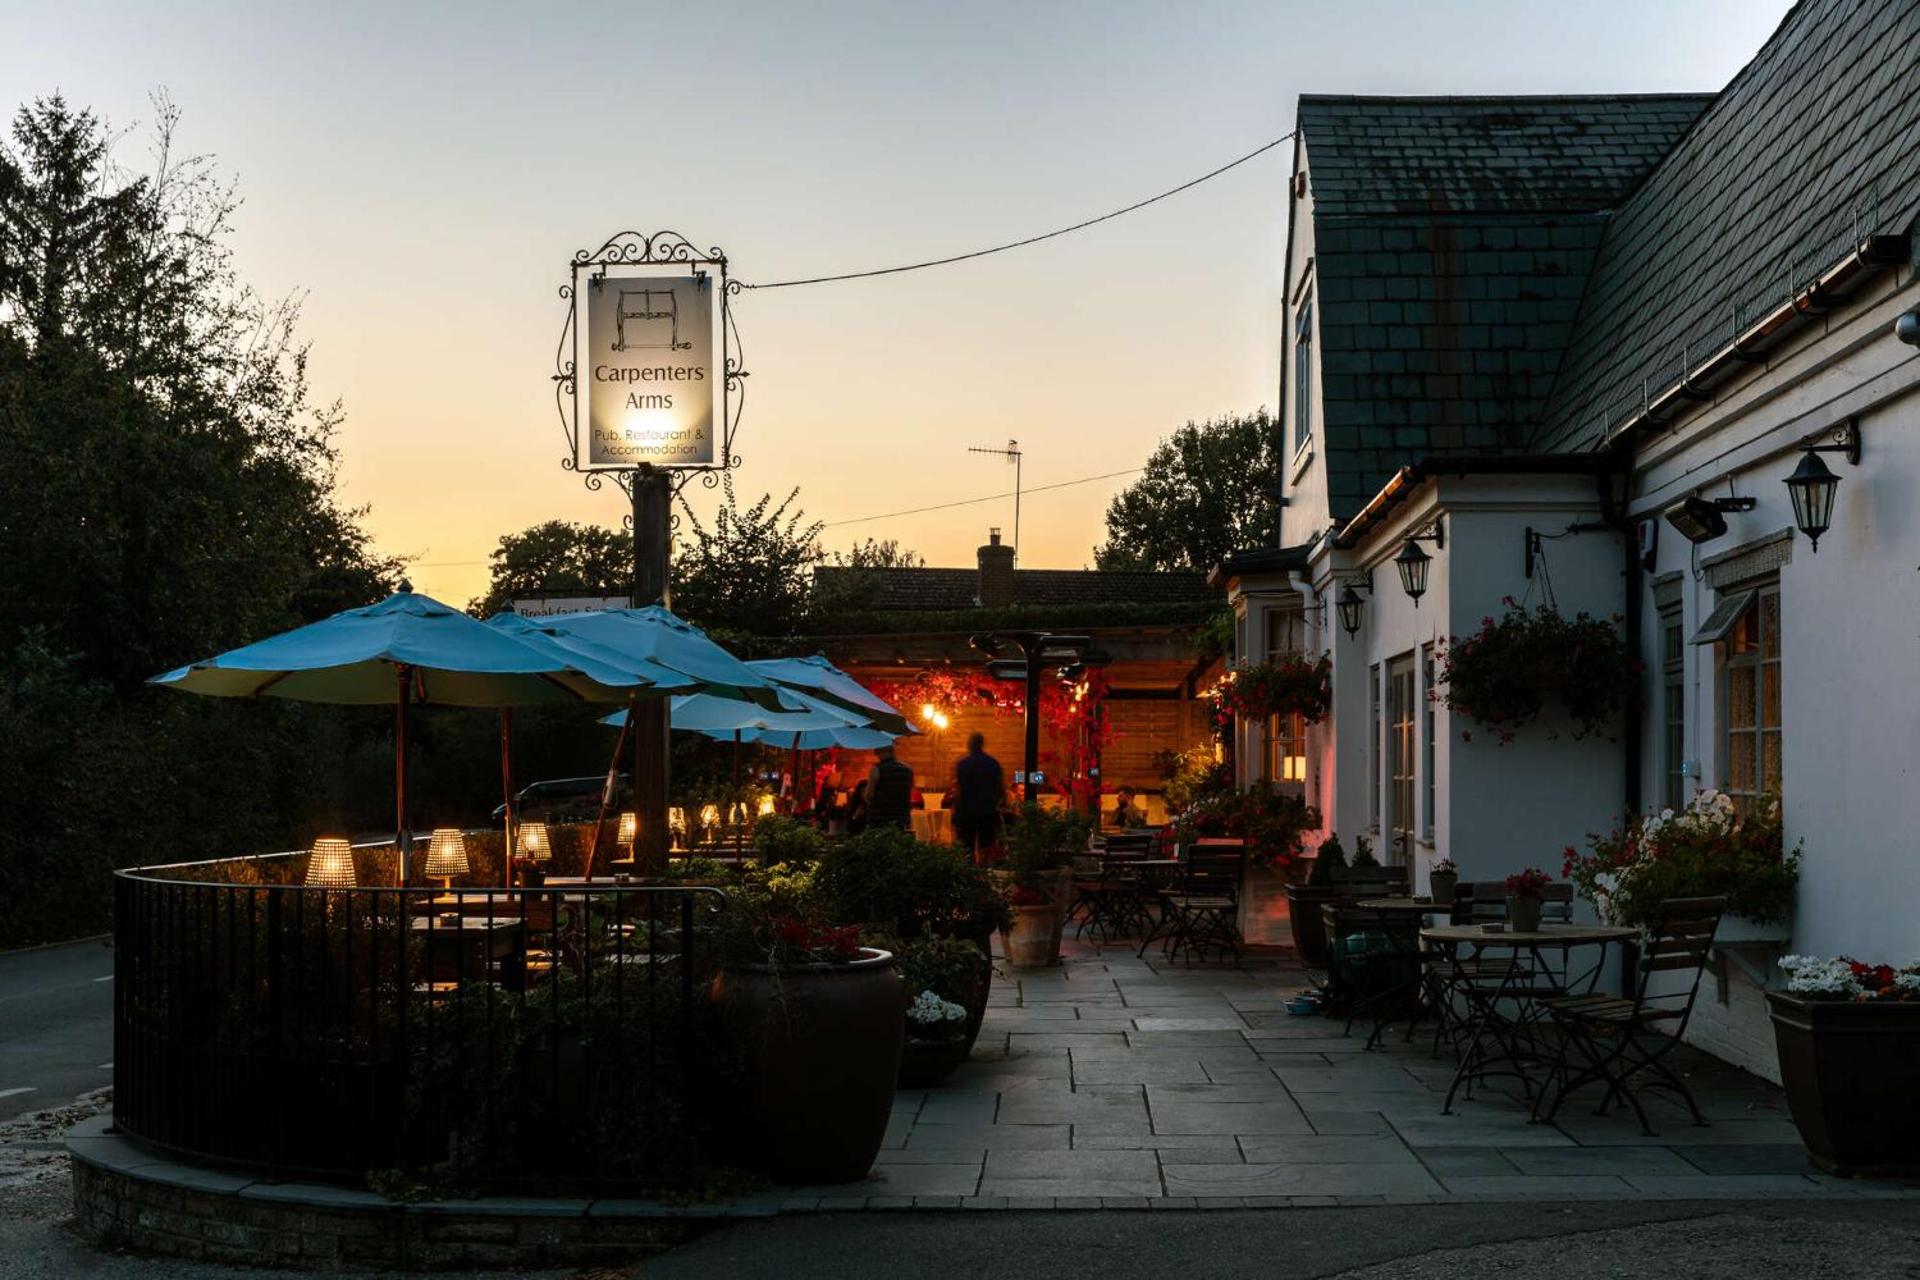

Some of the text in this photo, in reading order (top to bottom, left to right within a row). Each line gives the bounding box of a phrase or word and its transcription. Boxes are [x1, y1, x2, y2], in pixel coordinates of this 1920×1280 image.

[595, 365, 704, 384] Carpenters
[626, 392, 672, 408] Arms
[626, 429, 691, 441] Restaurant
[695, 429, 705, 440] &
[602, 445, 697, 455] Accommodation
